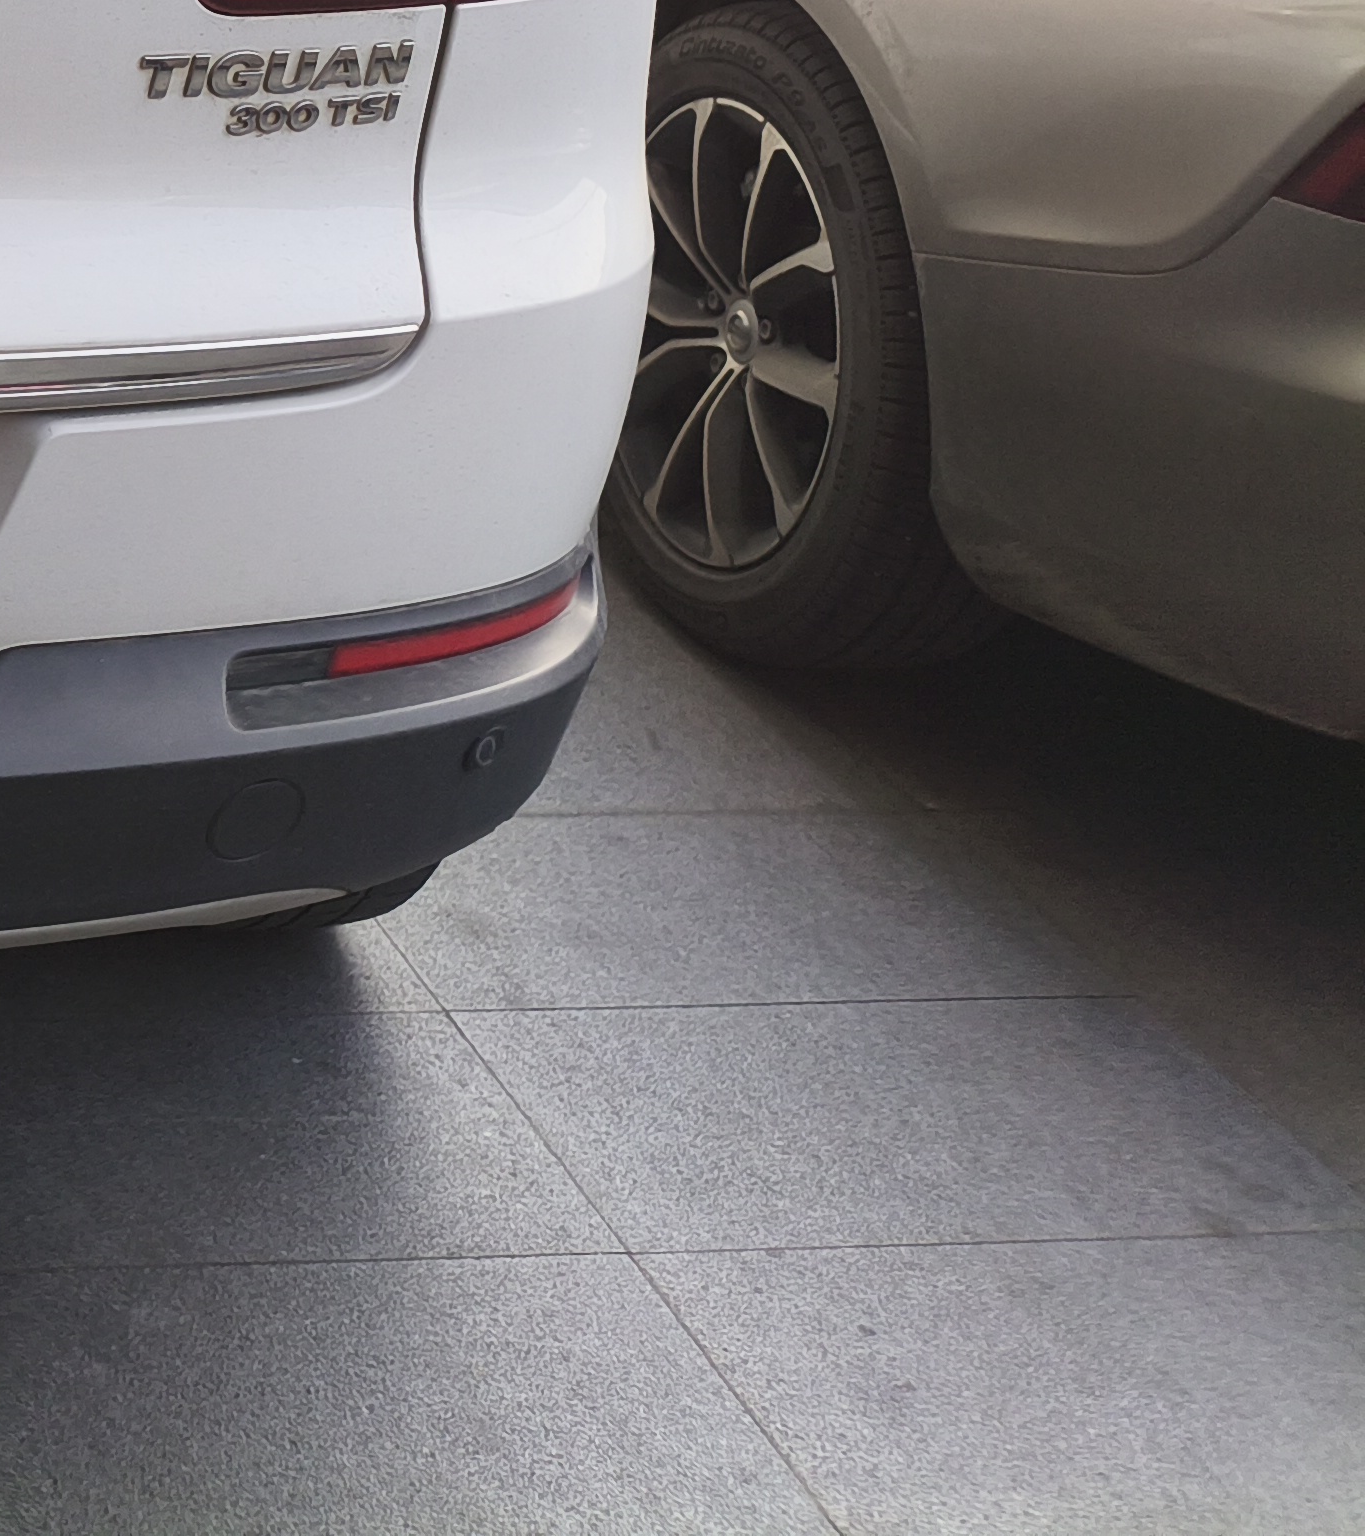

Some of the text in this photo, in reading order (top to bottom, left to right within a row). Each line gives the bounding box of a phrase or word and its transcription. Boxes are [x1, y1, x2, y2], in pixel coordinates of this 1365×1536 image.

[138, 38, 416, 100] TIGUAN
[226, 90, 401, 136] 300 TSI
